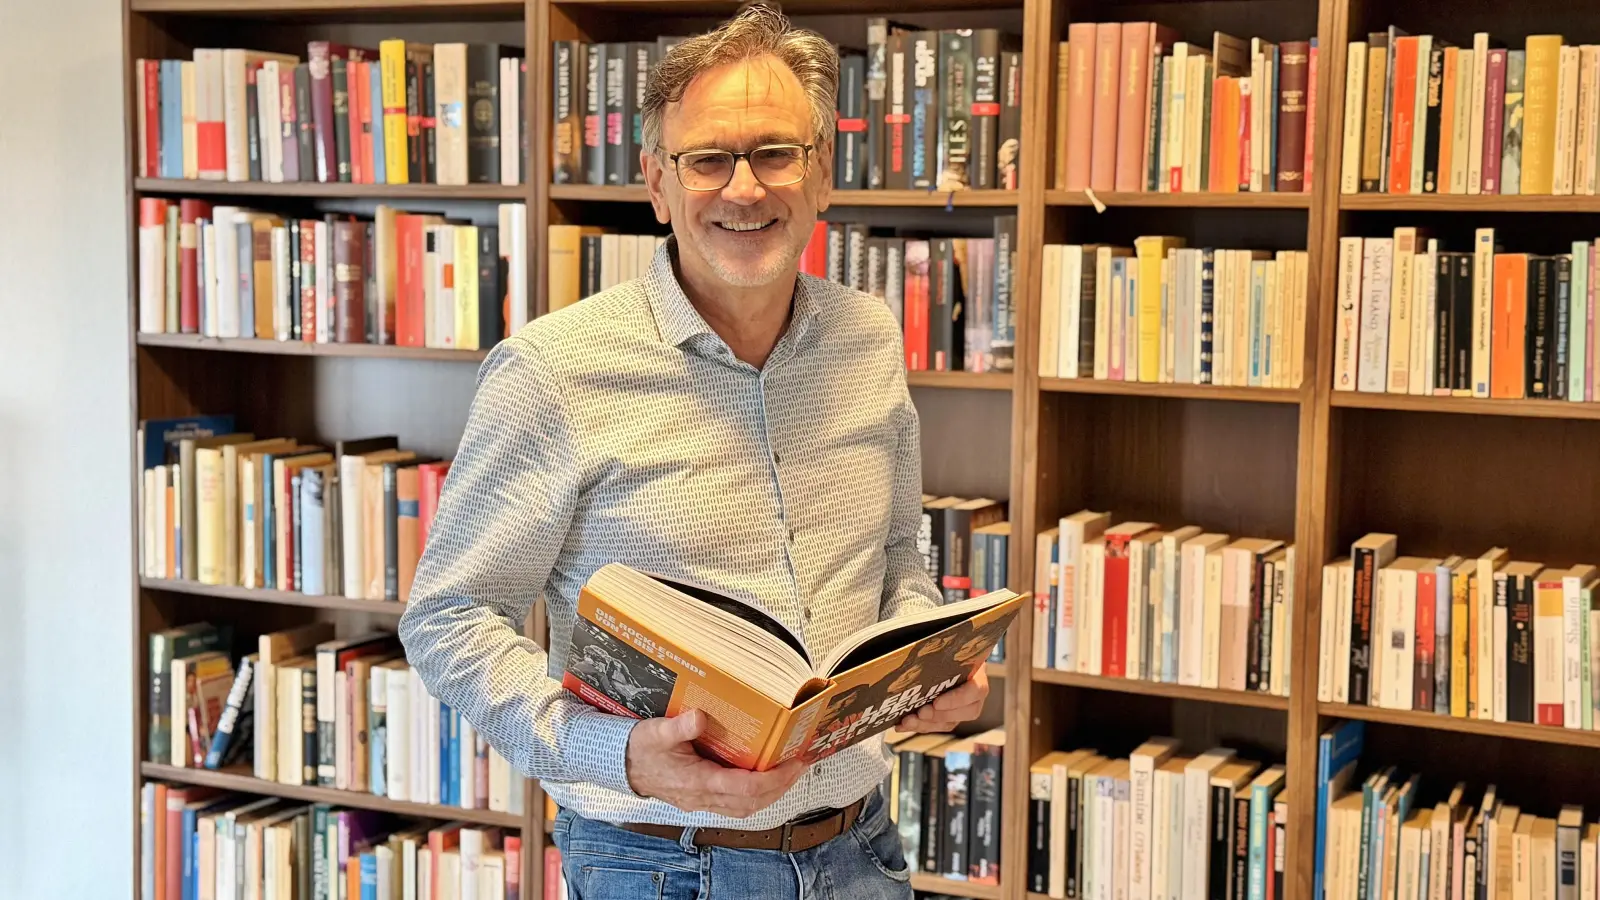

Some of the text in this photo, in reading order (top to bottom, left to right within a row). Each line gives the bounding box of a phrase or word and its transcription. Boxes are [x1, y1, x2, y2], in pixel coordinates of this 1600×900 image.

[975, 57, 995, 101] R.I.P.
[948, 119, 968, 164] ILES
[1366, 246, 1385, 330] SMALL ISLAND
[1496, 580, 1506, 606] PIPER
[594, 613, 620, 633] VON
[622, 631, 631, 640] A
[633, 638, 654, 654] BIS
[596, 607, 707, 679] DIE ROCKLEGENDE
[1566, 596, 1580, 645] Shaolin
[807, 673, 962, 752] ZEPPELIN
[818, 724, 870, 753] ALLE
[872, 692, 941, 729] SONGS
[860, 684, 923, 719] LED
[1133, 769, 1149, 826] Famine
